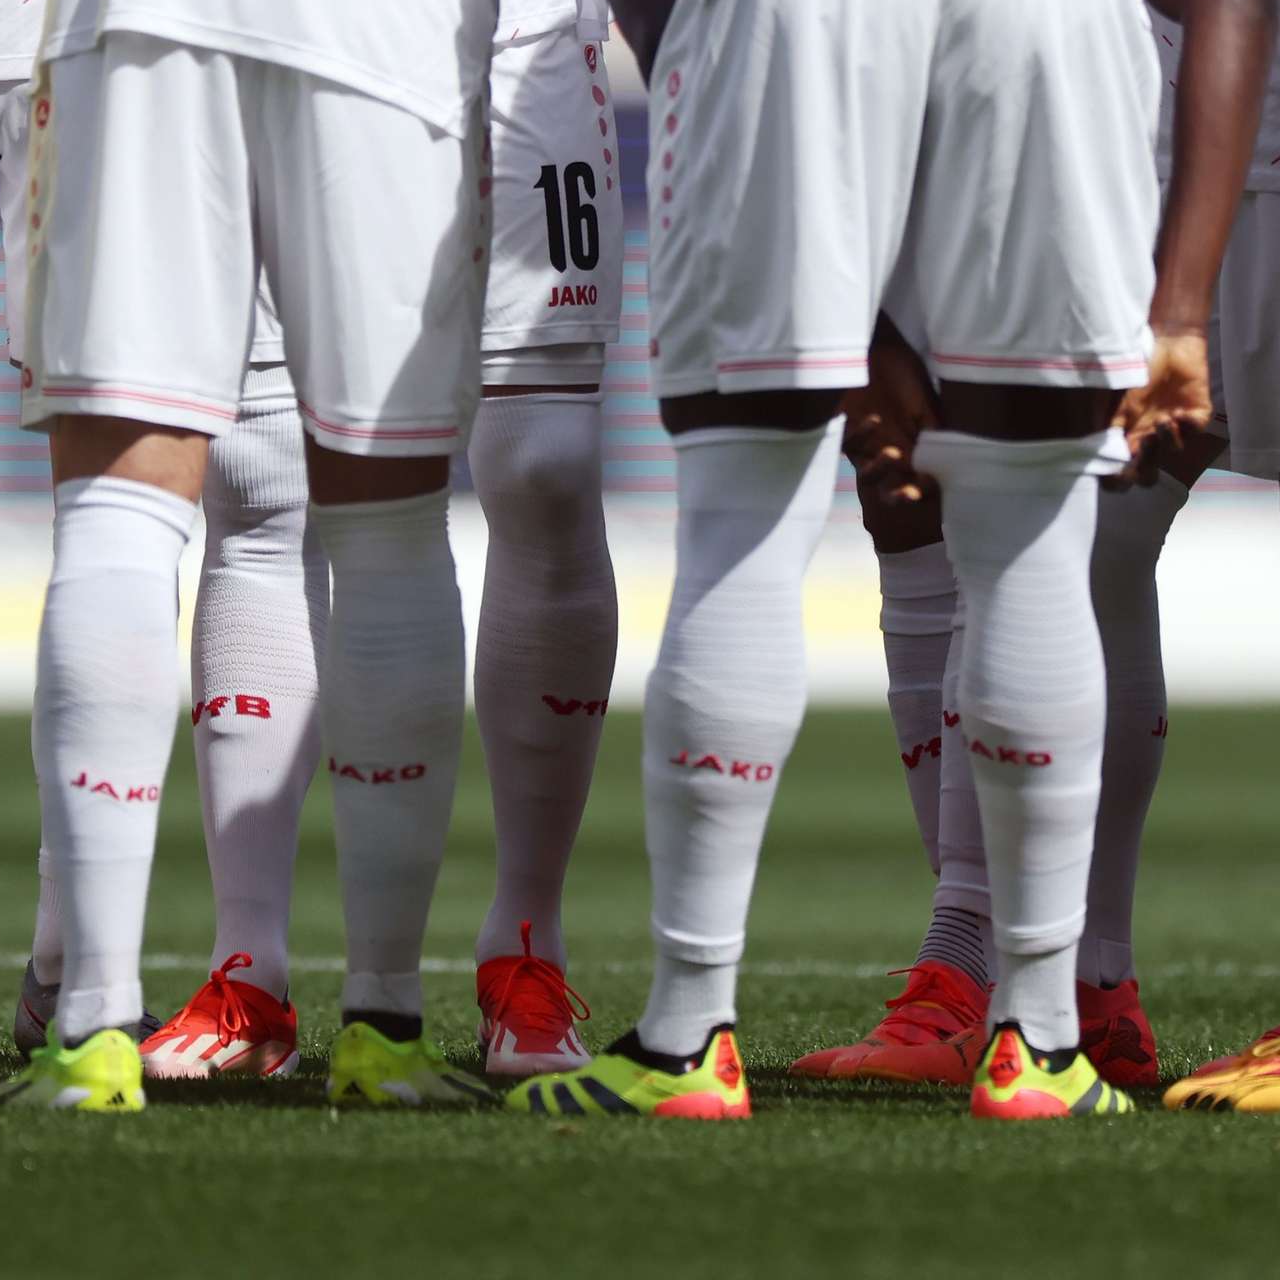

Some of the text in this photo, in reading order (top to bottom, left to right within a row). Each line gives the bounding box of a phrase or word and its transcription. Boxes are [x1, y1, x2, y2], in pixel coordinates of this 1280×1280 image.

[533, 160, 600, 273] 16
[548, 284, 598, 308] JAKO
[669, 748, 774, 782] JAKO
[70, 770, 159, 801] JAKO
